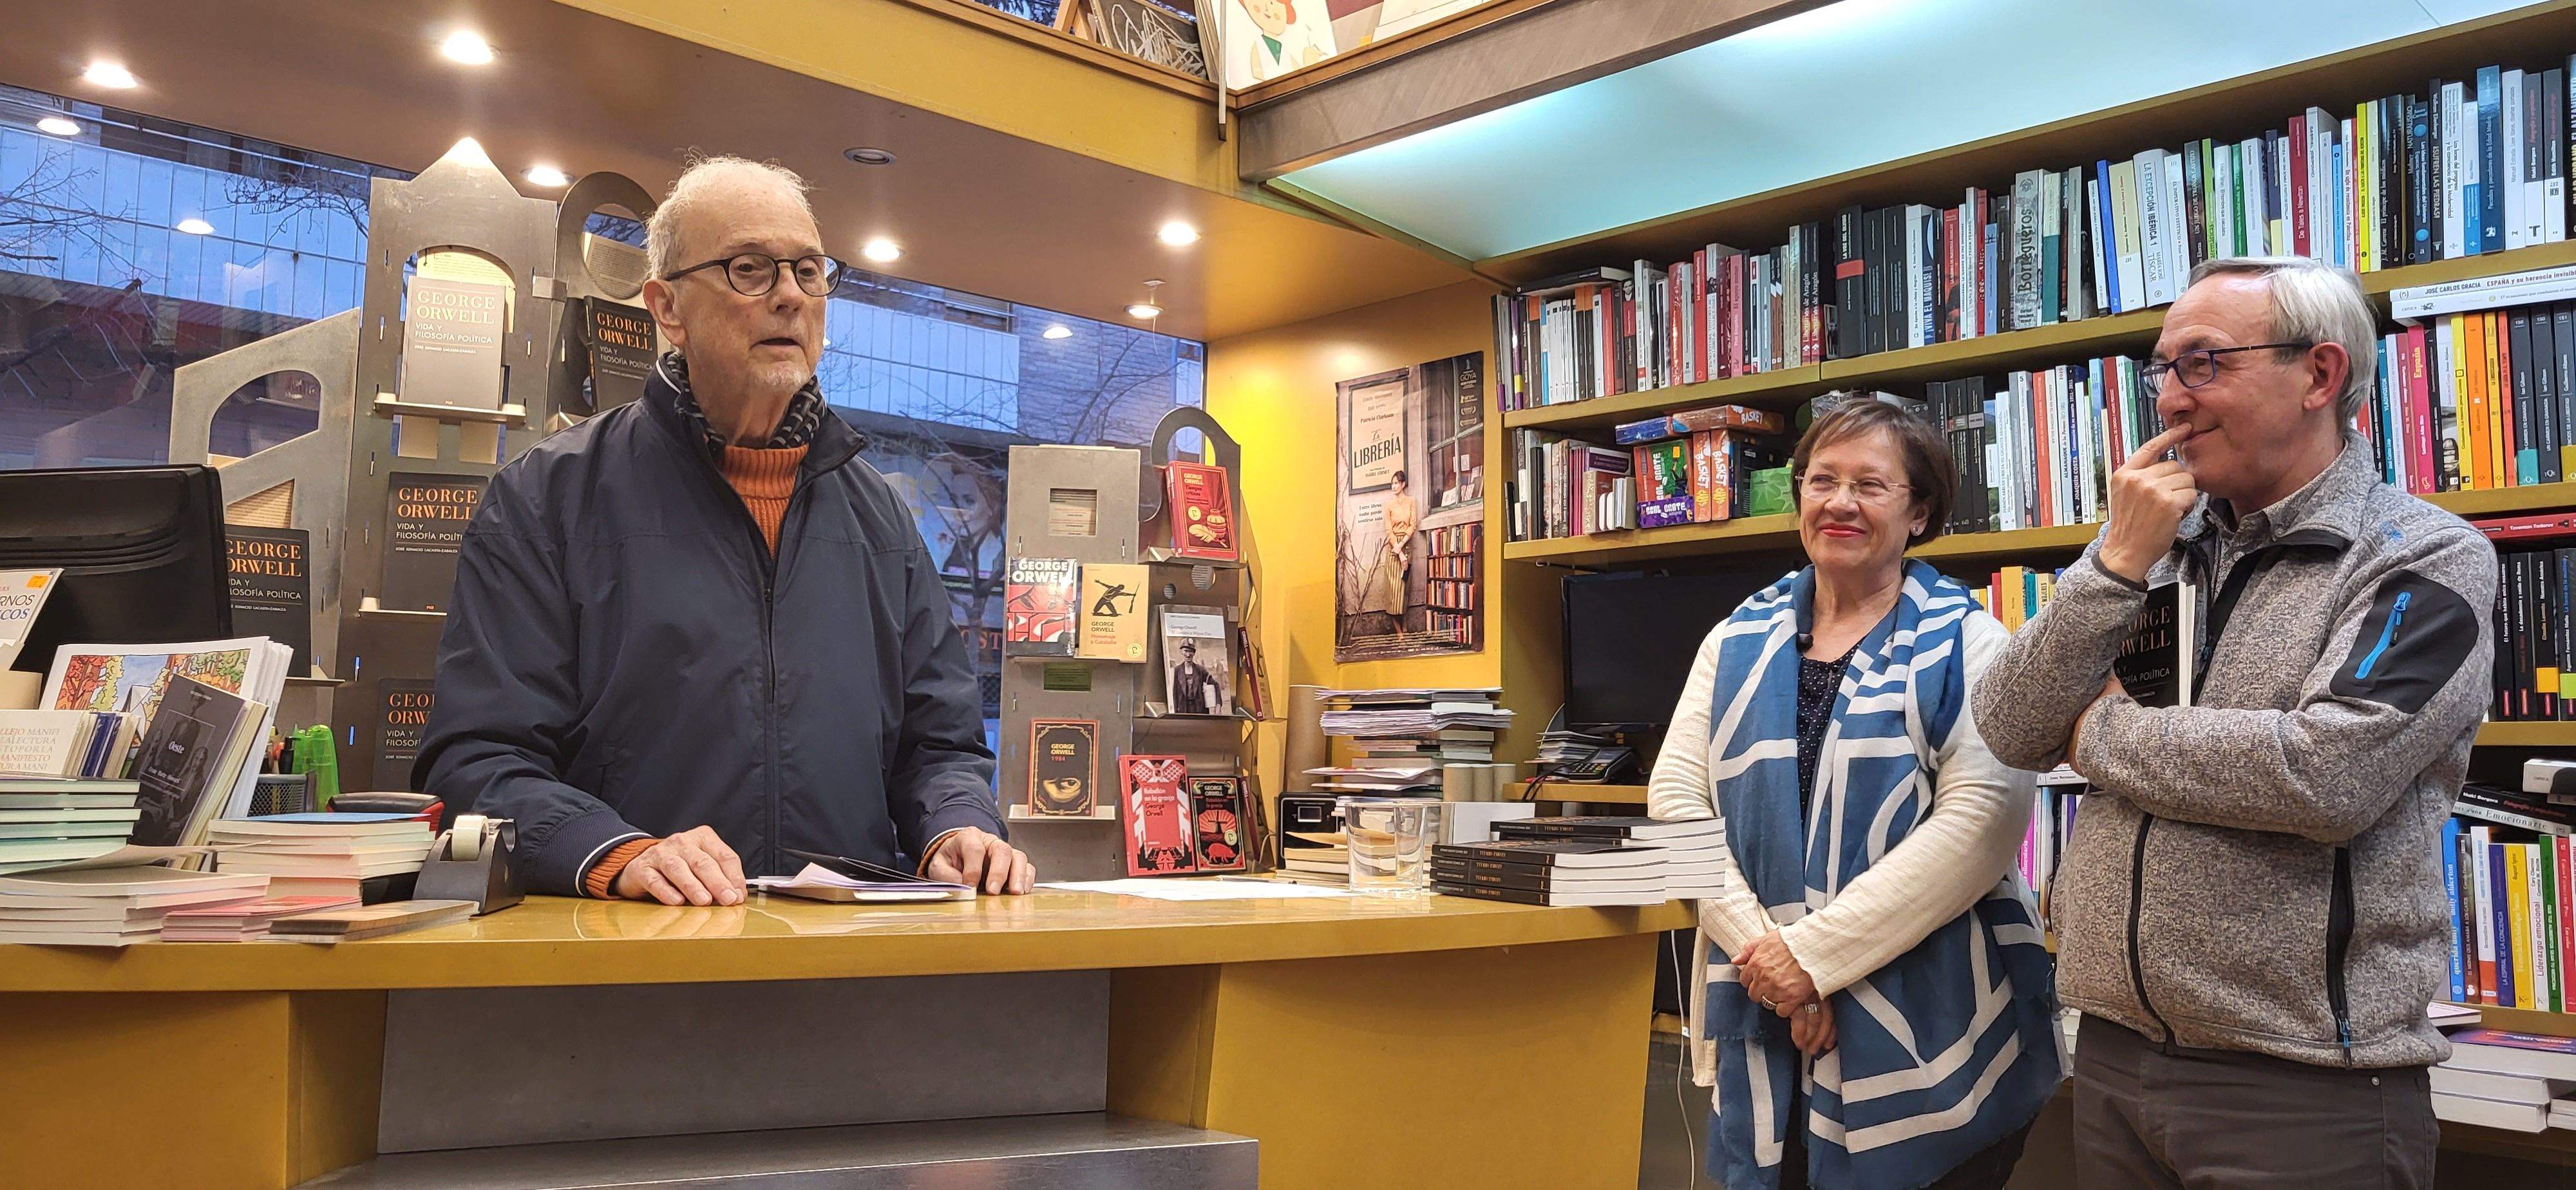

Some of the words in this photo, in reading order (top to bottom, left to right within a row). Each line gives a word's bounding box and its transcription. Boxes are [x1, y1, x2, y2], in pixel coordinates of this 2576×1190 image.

[2143, 163, 2152, 172] LA
[2145, 173, 2155, 212] EXCEPCIÓN
[2148, 213, 2158, 240] IBÉRICA
[2017, 208, 2035, 292] Borregueros
[2148, 253, 2157, 282] TÍSCAR
[1803, 273, 1811, 297] Aragón
[1811, 272, 1819, 296] Aragón
[1923, 273, 1933, 301] MAQUIS!
[2425, 286, 2438, 295] JOSÉ
[2439, 284, 2460, 293] CARLOS
[2461, 282, 2481, 291] GRACIA
[2486, 278, 2510, 287] ESPAÑA
[2525, 272, 2552, 281] herencia
[417, 290, 495, 310] GEORGE
[417, 306, 495, 324] ORWELL
[597, 312, 651, 335] GEORGE
[1924, 314, 1933, 332] ¡VIVA
[415, 331, 455, 341] FILOSOFÍA
[457, 334, 493, 344] POLÍTICA
[598, 328, 652, 351] ORWELL
[600, 354, 627, 365] FILOSOFÍA
[629, 360, 652, 370] POLÍTICA
[2412, 346, 2423, 379] España
[1460, 372, 1476, 381] GOYA
[1741, 413, 1763, 424] BASKET
[1354, 433, 1401, 468] LIBRERÍA
[1694, 452, 1710, 489] BASKET
[1712, 451, 1727, 486] BASKET
[399, 487, 478, 504] GEORGE
[396, 532, 436, 540] FILOSOFÍA
[1018, 561, 1068, 571] GEORGE
[267, 590, 301, 600] POLÍTICA
[2128, 606, 2170, 632] ORGE
[2140, 667, 2170, 680] POLÍTICA
[390, 694, 435, 707] GEO
[388, 710, 430, 724] ORW
[169, 741, 185, 754] Oeste
[2533, 902, 2542, 938] emocional
[2501, 949, 2506, 957] DE
[2537, 941, 2545, 977] Liderazgo
